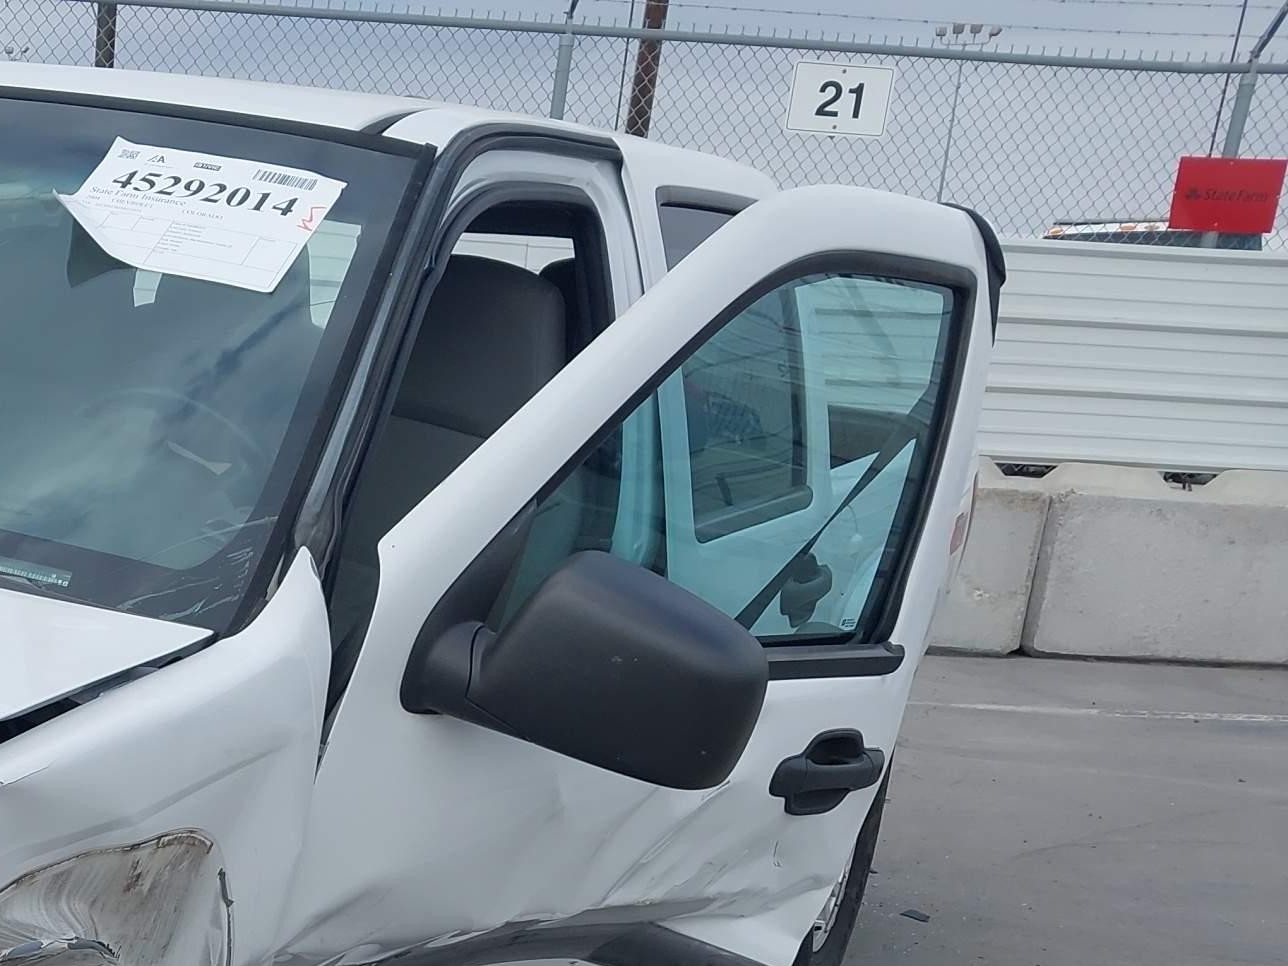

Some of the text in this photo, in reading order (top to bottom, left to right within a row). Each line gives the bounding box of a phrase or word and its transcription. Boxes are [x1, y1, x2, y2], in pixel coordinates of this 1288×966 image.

[814, 80, 865, 119] 21
[90, 186, 113, 196] State
[115, 189, 139, 200] Farm
[142, 193, 187, 207] Insurance
[112, 170, 299, 216] 45292014
